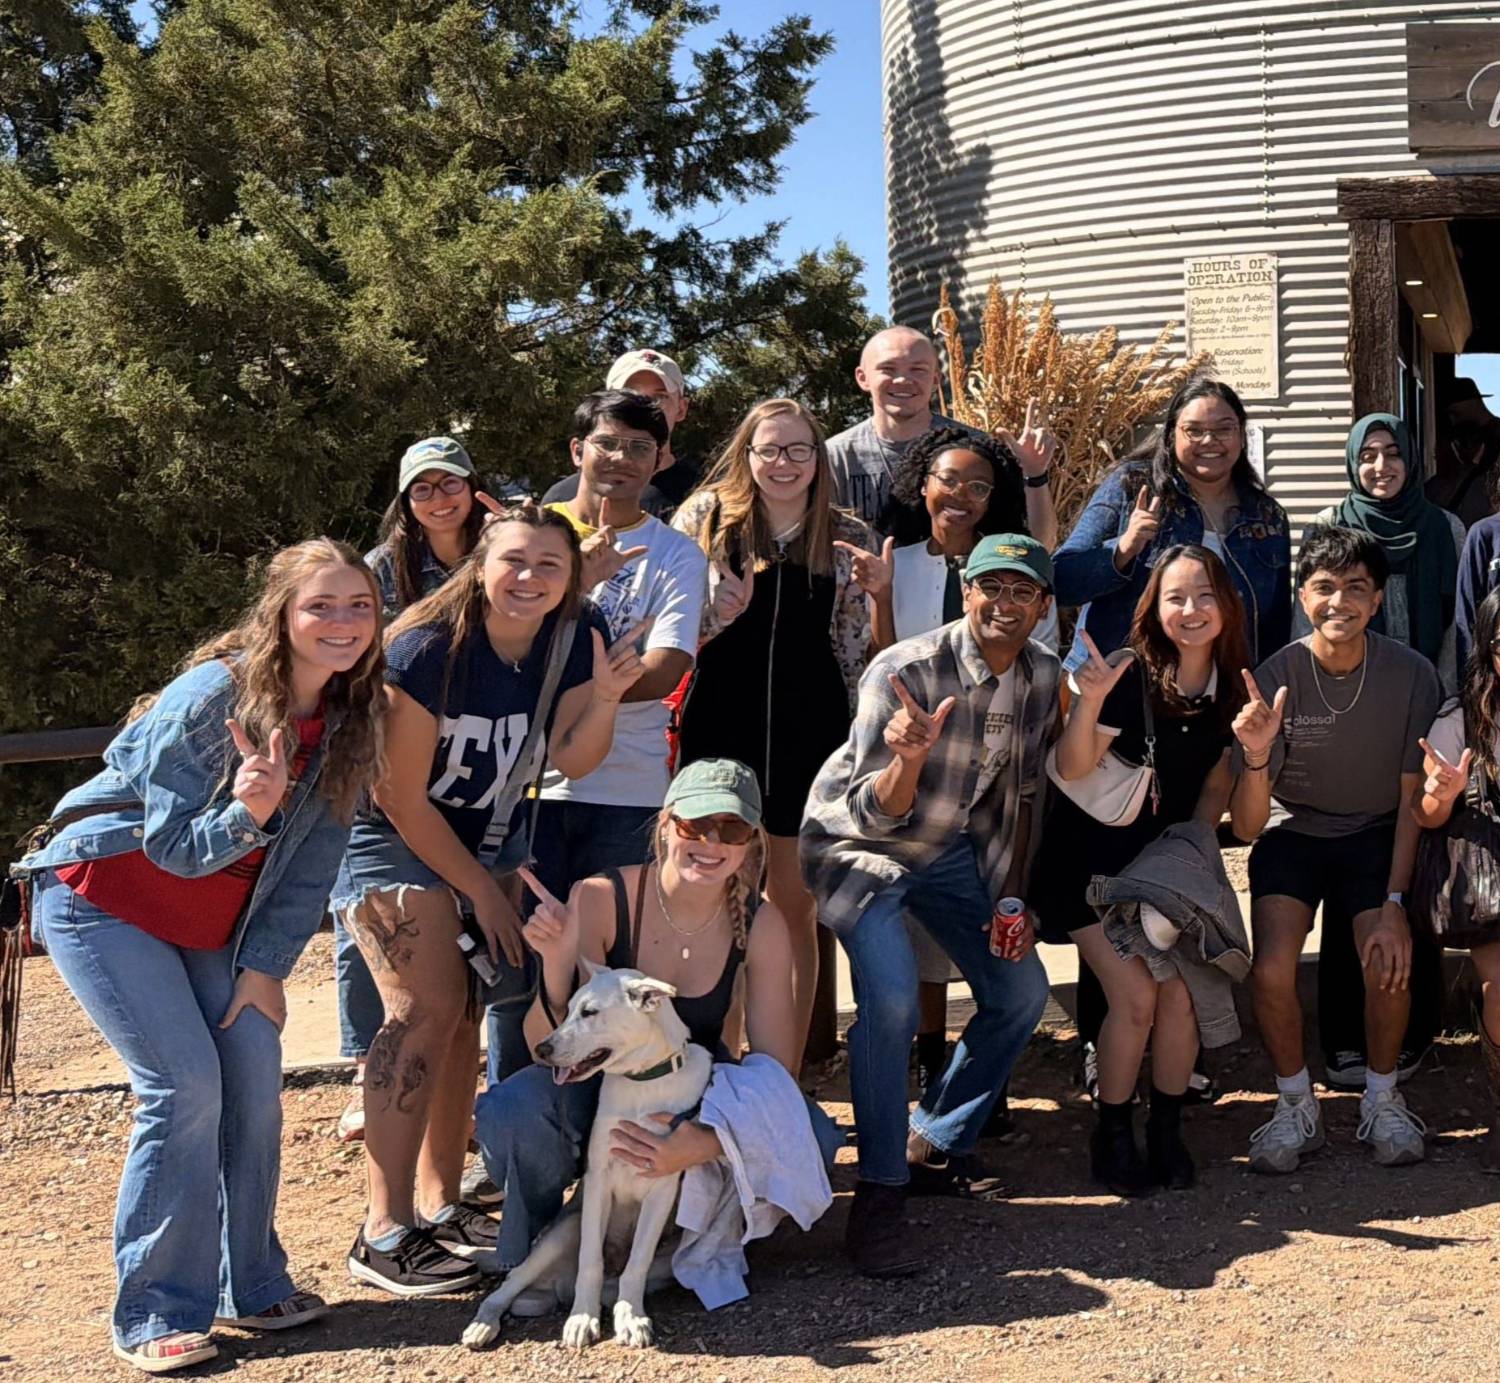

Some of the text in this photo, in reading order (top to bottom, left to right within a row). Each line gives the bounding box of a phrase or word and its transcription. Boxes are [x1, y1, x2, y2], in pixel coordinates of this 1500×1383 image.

[1192, 258, 1268, 273] HOURS OF
[1188, 271, 1273, 286] OPERATION
[1191, 296, 1214, 307] Open
[1215, 296, 1224, 304] to
[1226, 295, 1240, 303] the
[1235, 380, 1272, 392] Mondays
